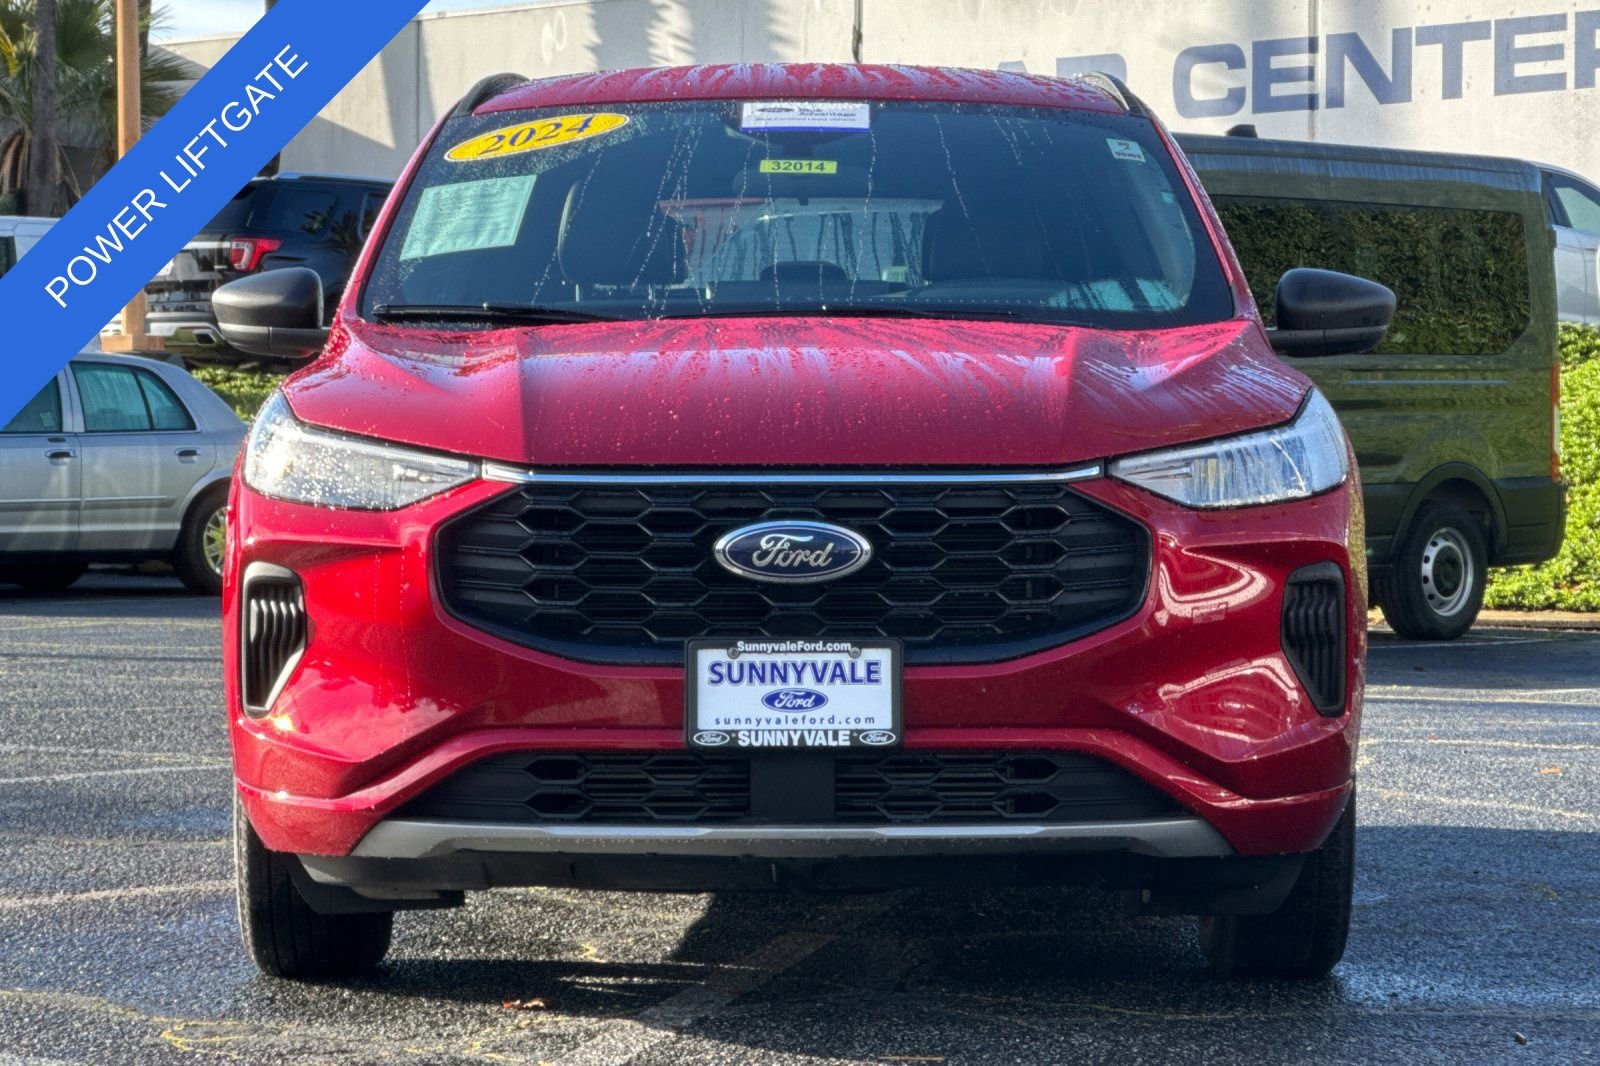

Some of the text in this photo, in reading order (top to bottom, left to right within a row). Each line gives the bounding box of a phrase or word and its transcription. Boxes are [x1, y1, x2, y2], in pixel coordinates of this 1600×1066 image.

[479, 114, 594, 156] 2024
[771, 161, 826, 171] 32014
[752, 534, 834, 567] Ford
[737, 641, 852, 653] SunnyvaleFord.com
[708, 660, 882, 686] SUNNYVALE
[774, 690, 815, 708] Ford
[715, 715, 875, 726] sunnyvaleford.com
[737, 731, 850, 746] SUNNYVALE
